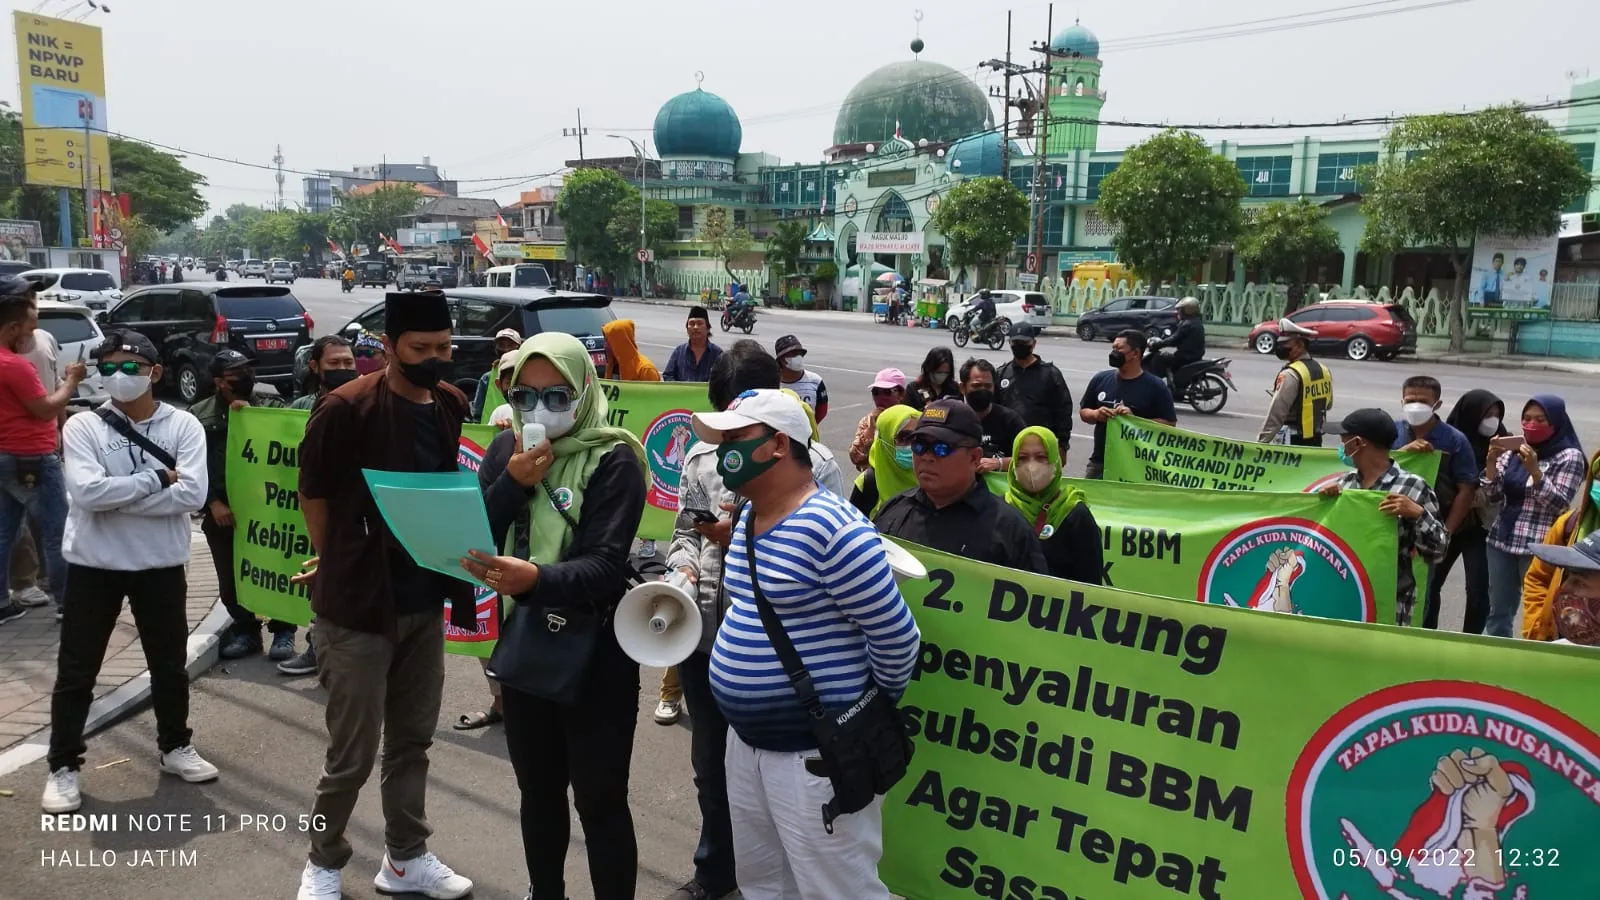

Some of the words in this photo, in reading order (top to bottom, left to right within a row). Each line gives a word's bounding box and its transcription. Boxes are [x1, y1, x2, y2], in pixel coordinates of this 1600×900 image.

[28, 32, 59, 49] NIK
[64, 41, 73, 49] =
[29, 48, 84, 68] NPWP
[30, 64, 80, 83] BARU
[1305, 381, 1331, 399] POLISI
[241, 438, 258, 464] 4.
[267, 440, 301, 468] Du
[1120, 423, 1154, 443] KAMI
[1156, 431, 1207, 453] ORMAS
[1213, 440, 1245, 461] TKN
[1253, 447, 1303, 467] JATIM
[1134, 446, 1158, 463] DAN
[1162, 451, 1231, 476] SRIKANDI
[1144, 465, 1205, 489] SRIKANDI
[1121, 525, 1182, 565] BBM
[1222, 540, 1256, 567] TAPAL
[1256, 532, 1287, 546] KUDA
[1290, 532, 1348, 580] NUSANTARA
[922, 569, 964, 613] 2.
[987, 578, 1228, 675] Dukung
[910, 640, 1241, 750] penyaluran
[1337, 720, 1408, 772] TAPAL
[1410, 713, 1480, 737] KUDA
[899, 704, 1095, 786] subsidi
[1105, 751, 1254, 833] BBM
[905, 769, 1039, 839] Agar
[1051, 806, 1227, 900] Tepat
